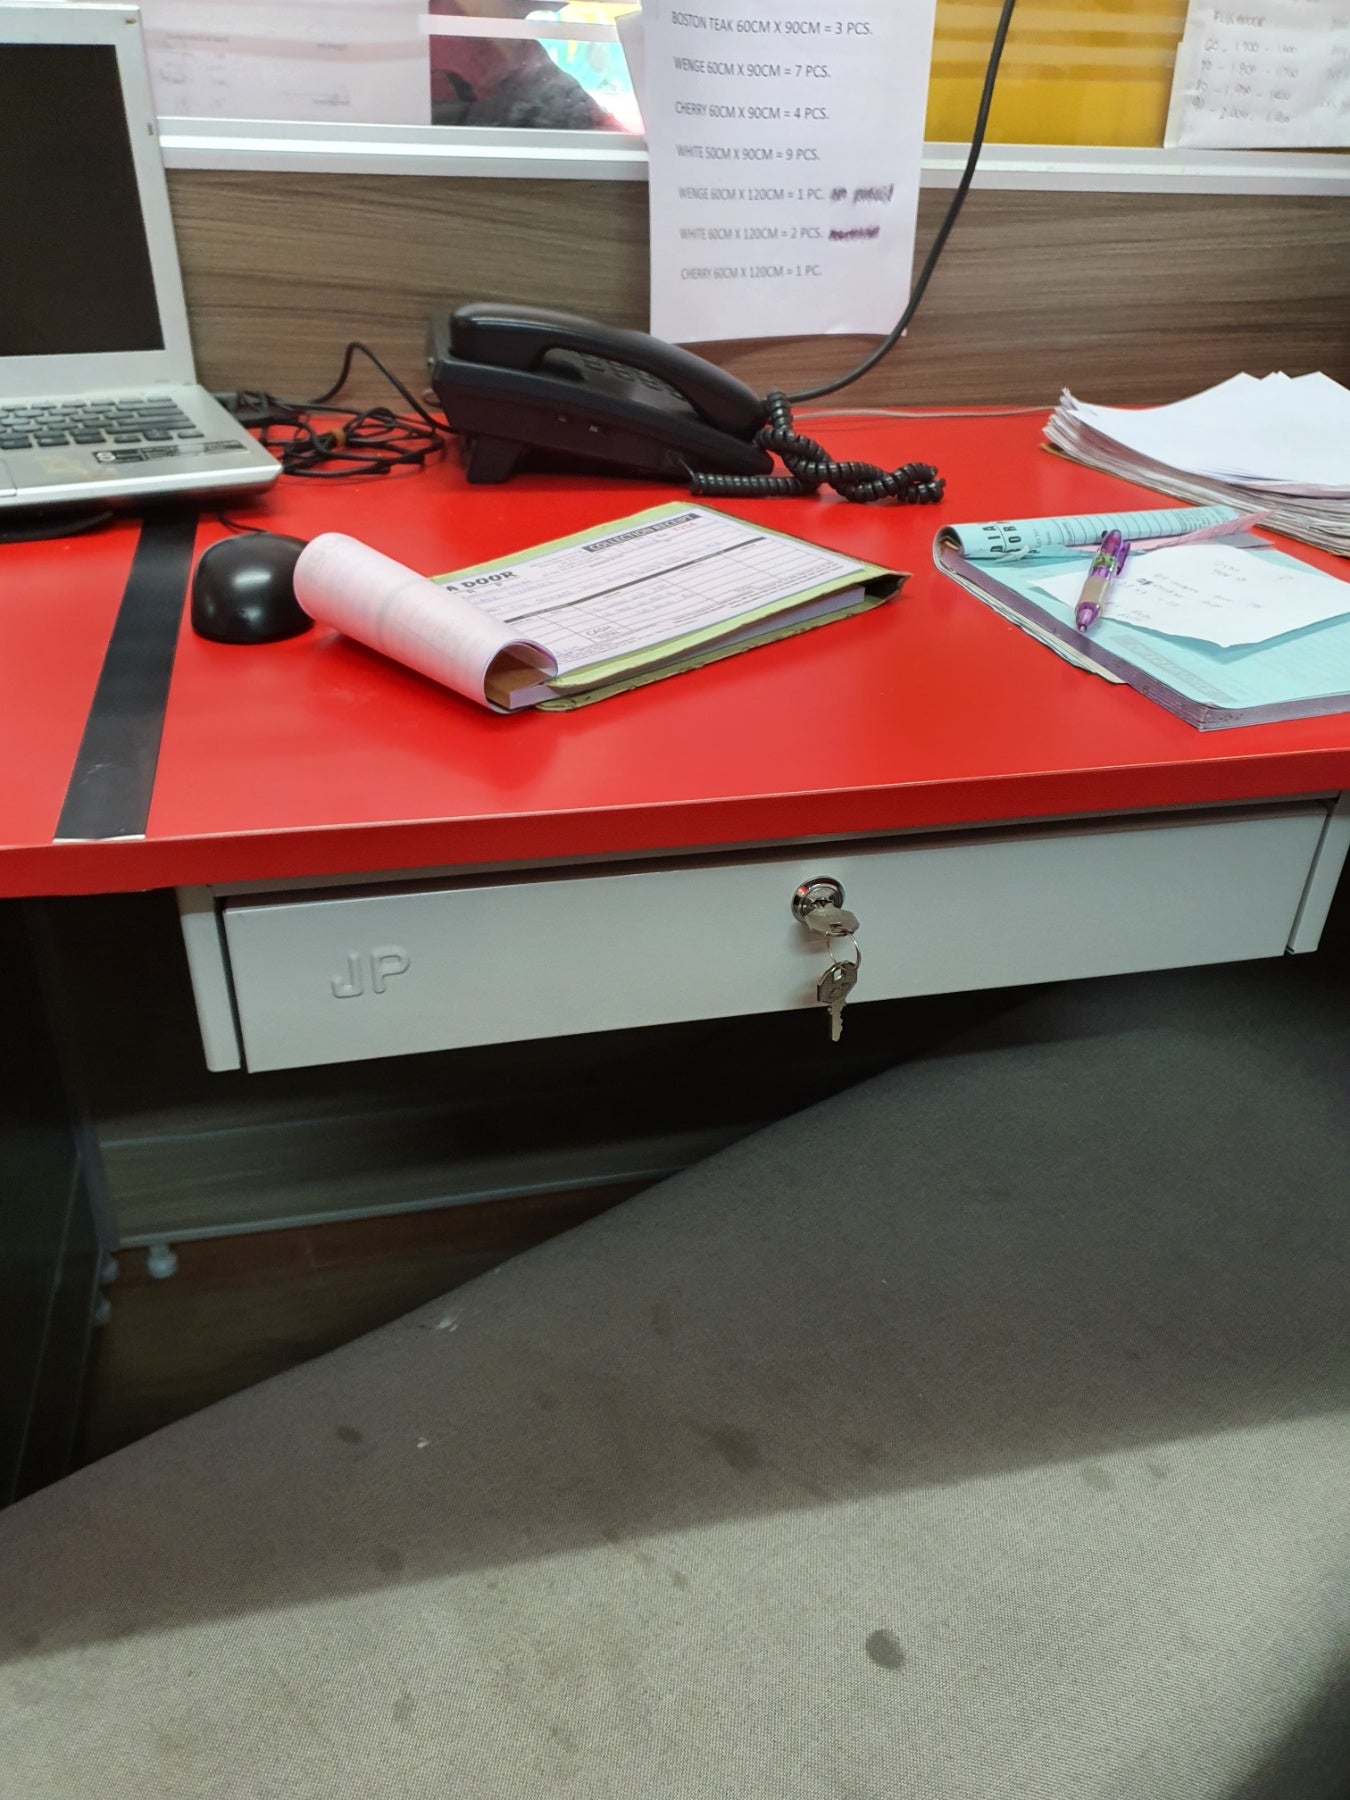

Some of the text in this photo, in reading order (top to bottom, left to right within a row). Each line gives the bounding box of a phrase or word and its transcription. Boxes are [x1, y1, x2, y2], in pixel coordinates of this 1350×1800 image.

[672, 11, 706, 29] BOSTON
[709, 17, 733, 32] TEAK
[737, 20, 770, 33] 60CM
[774, 20, 782, 34] X
[785, 22, 820, 34] 90CM
[835, 23, 842, 34] 3
[847, 23, 873, 35] PCS.
[673, 57, 705, 73] WENGE
[707, 61, 735, 75] 60CM
[737, 64, 745, 76] X
[747, 64, 780, 77] 90CM
[795, 65, 802, 77] 7
[806, 65, 831, 78] PCS.
[675, 101, 707, 115] CHERRY
[709, 105, 735, 118] 60CM
[738, 106, 745, 118] X
[748, 107, 780, 119] 90CM
[794, 107, 801, 119] 4
[805, 107, 830, 120] PCS.
[676, 144, 703, 159] WHITE
[733, 149, 740, 160] X
[743, 149, 773, 160] 90CM
[786, 149, 793, 160] 9
[678, 186, 708, 200] WENGE
[738, 188, 745, 200] X
[749, 188, 784, 200] 120CM
[797, 188, 803, 200] 1
[680, 228, 706, 240] WHITE
[735, 228, 741, 240] X
[744, 228, 778, 240] 120CM
[791, 227, 797, 239] 2
[681, 268, 712, 280] CHERRY
[740, 267, 746, 279] X
[750, 266, 784, 278] 120CM
[796, 266, 802, 277] 1
[588, 527, 652, 552] COLLECTION
[652, 514, 694, 533] RECEIPT
[460, 570, 517, 588] DOOR
[331, 946, 411, 999] JP
